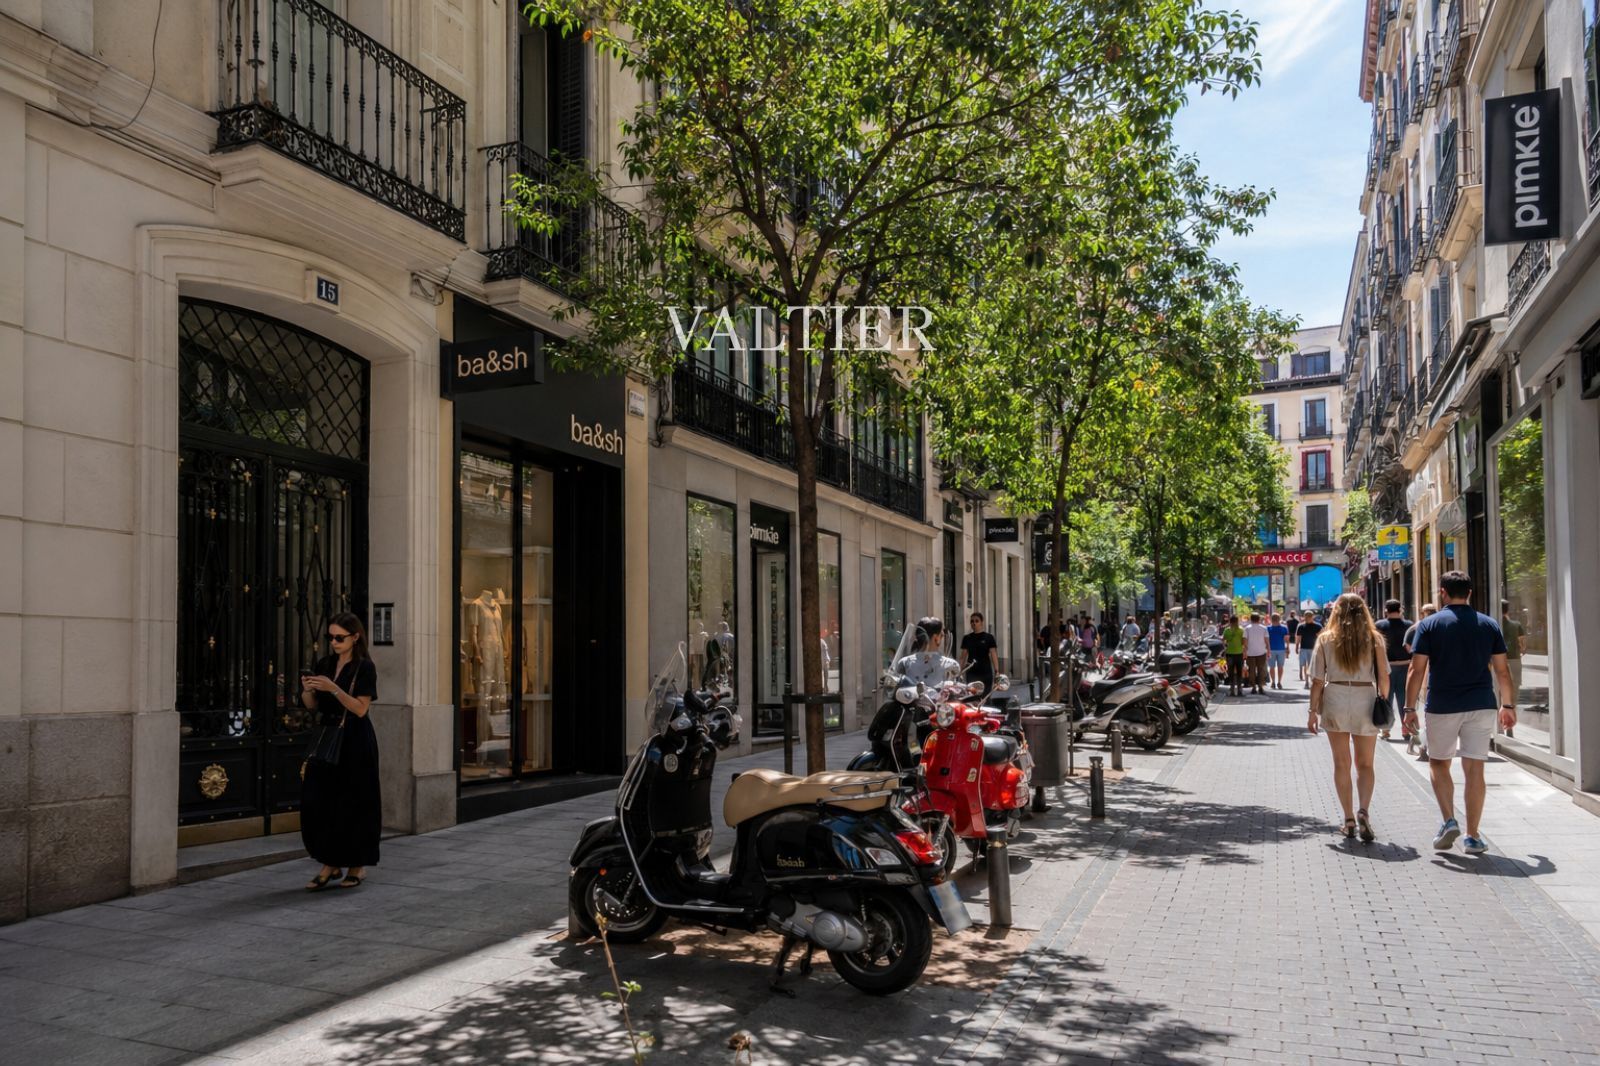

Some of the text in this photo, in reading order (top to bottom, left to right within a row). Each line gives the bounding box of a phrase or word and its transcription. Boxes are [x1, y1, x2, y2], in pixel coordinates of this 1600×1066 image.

[320, 281, 336, 301] 15
[457, 346, 528, 377] ba&sh
[571, 414, 623, 455] ba&sh
